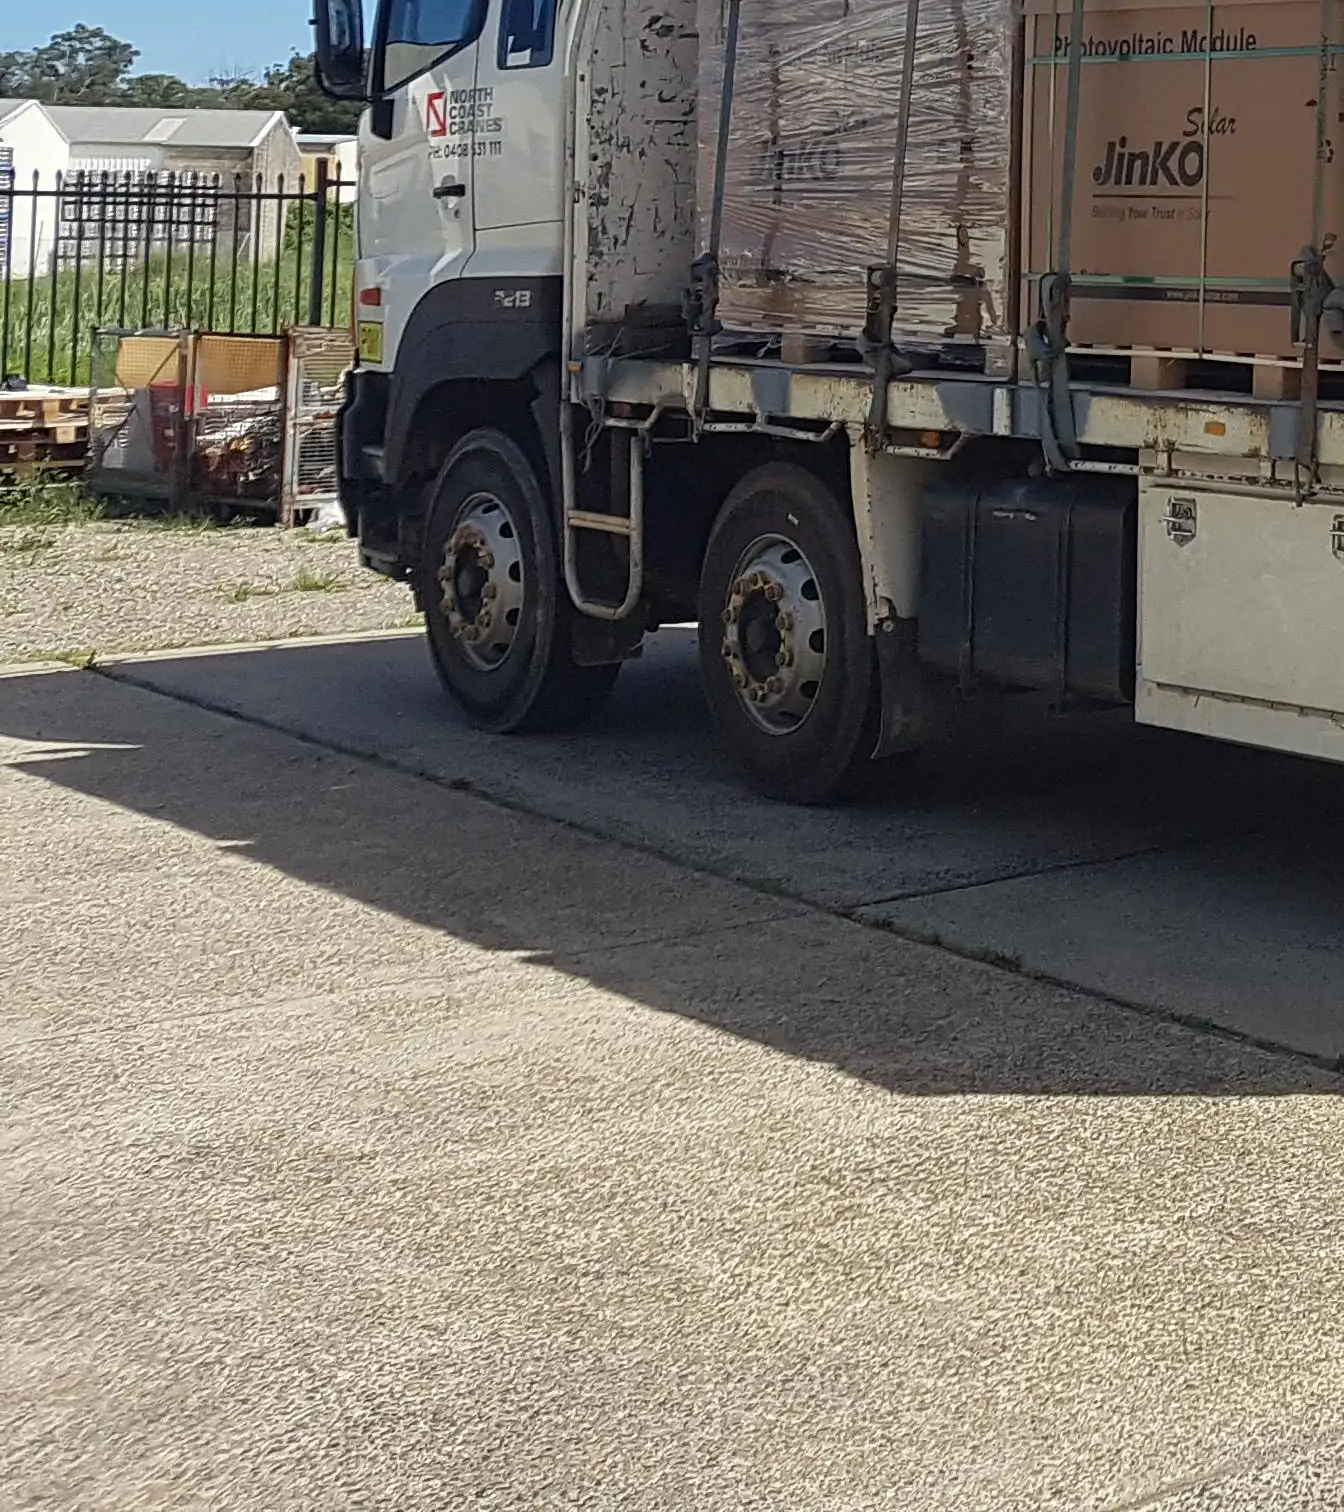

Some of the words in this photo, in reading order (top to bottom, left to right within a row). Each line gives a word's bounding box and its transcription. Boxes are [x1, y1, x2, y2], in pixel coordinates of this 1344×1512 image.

[1055, 31, 1174, 57] Phtovoltaic
[449, 87, 494, 105] NORTH
[449, 103, 493, 120] COAST
[449, 117, 504, 136] CRANES
[489, 140, 502, 156] 111
[1093, 135, 1205, 187] JinKO
[1152, 206, 1176, 220] Trust
